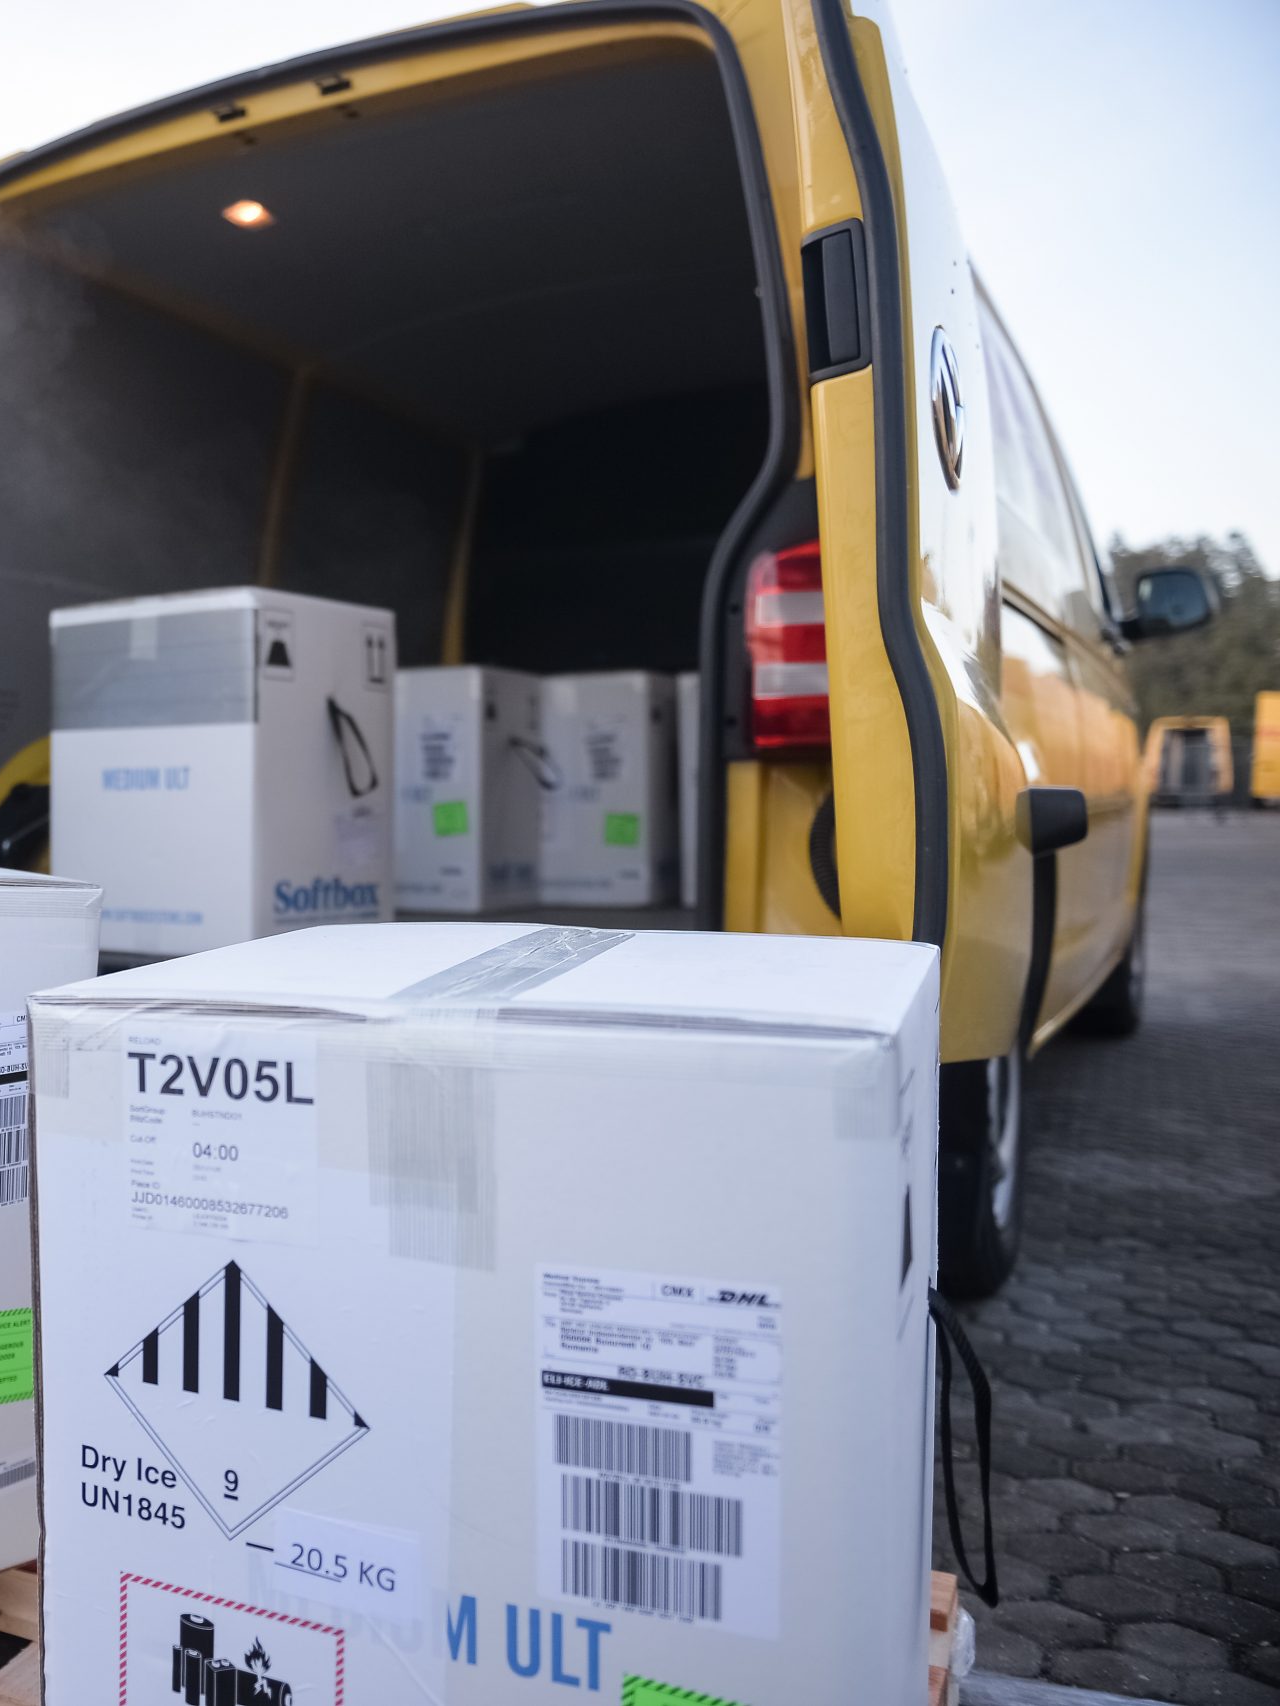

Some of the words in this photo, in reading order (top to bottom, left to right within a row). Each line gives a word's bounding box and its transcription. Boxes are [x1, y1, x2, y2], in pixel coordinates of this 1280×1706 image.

[274, 877, 380, 914] Softbox
[127, 1051, 315, 1105] T2V05L
[192, 1142, 239, 1162] 04:00
[717, 1288, 772, 1308] DHL
[81, 1444, 127, 1482] Dry
[136, 1457, 177, 1489] Ice
[223, 1468, 239, 1493] 9
[81, 1482, 186, 1530] UN1845
[290, 1542, 348, 1579] 20.5
[359, 1560, 397, 1593] KG
[506, 1602, 612, 1692] ULT
